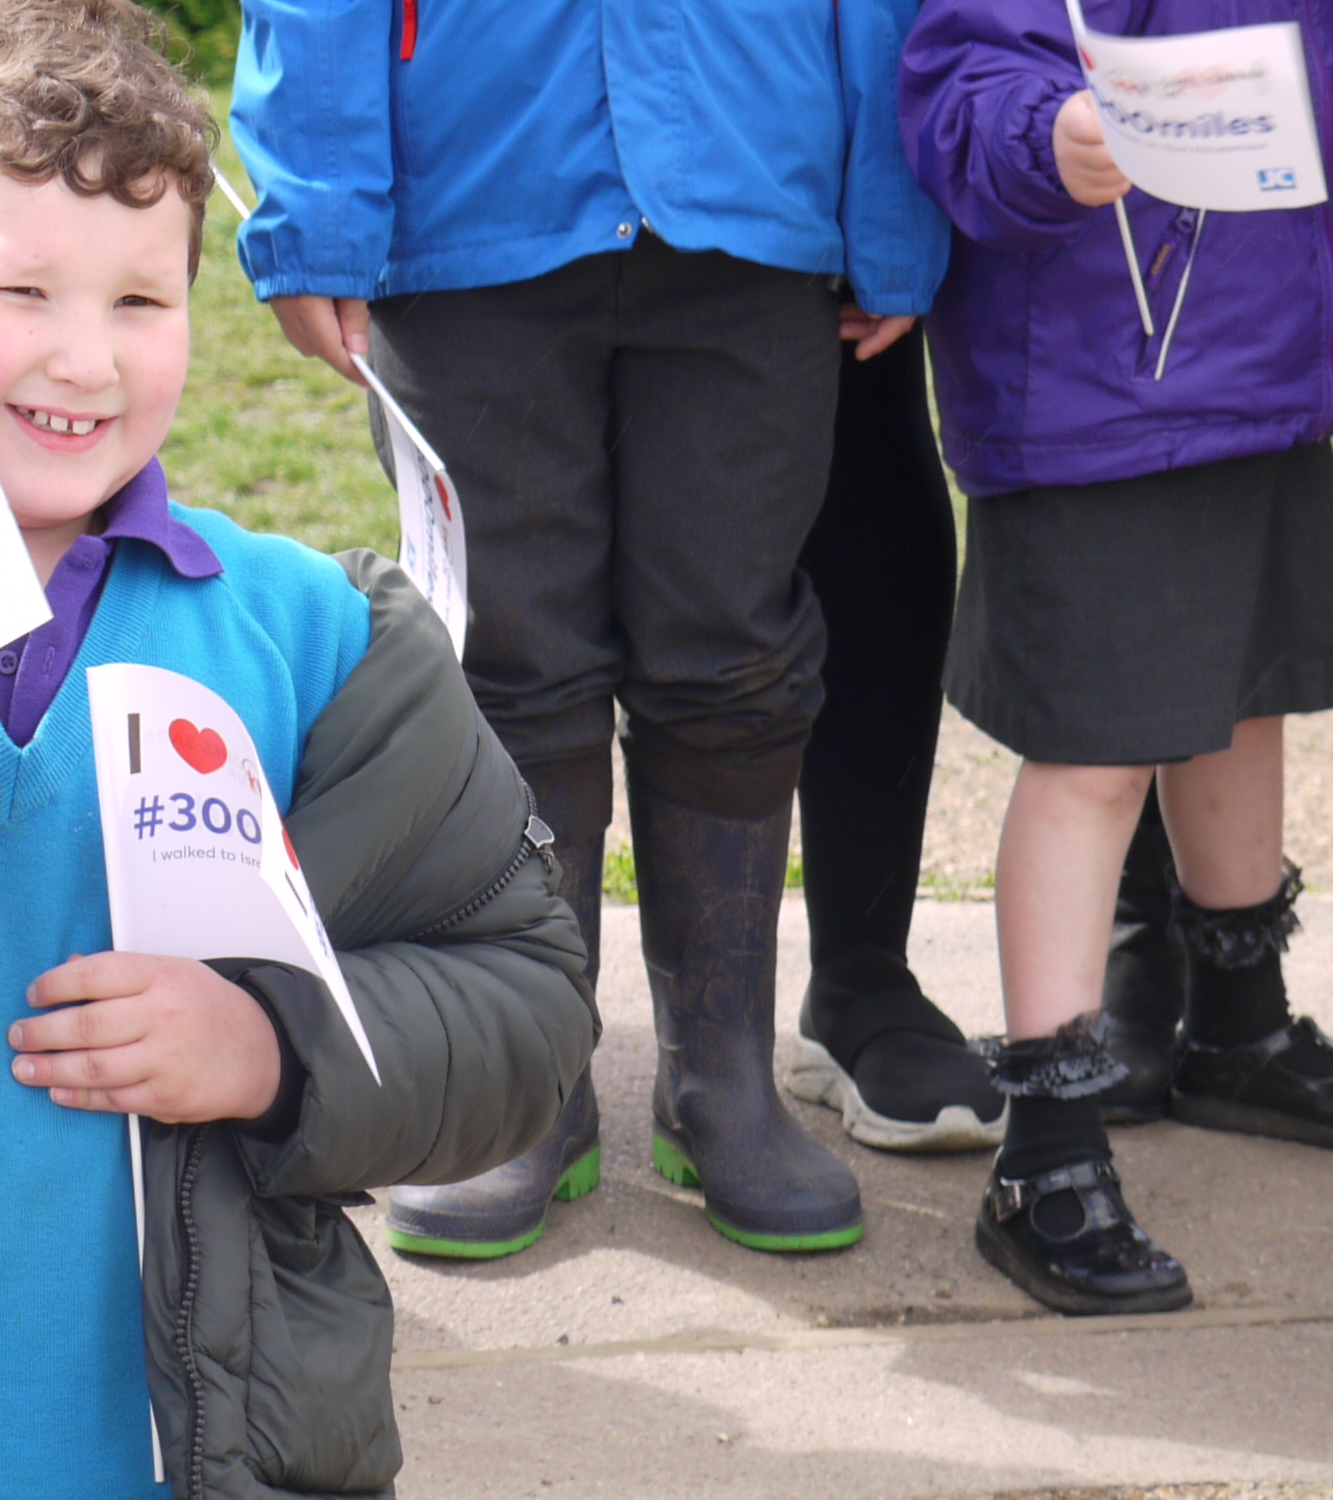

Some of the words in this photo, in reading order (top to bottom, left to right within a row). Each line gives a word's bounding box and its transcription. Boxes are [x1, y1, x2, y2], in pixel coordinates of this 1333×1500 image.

[127, 713, 141, 775] I
[153, 849, 157, 863] I
[160, 845, 216, 861] walked
[221, 848, 236, 862] to
